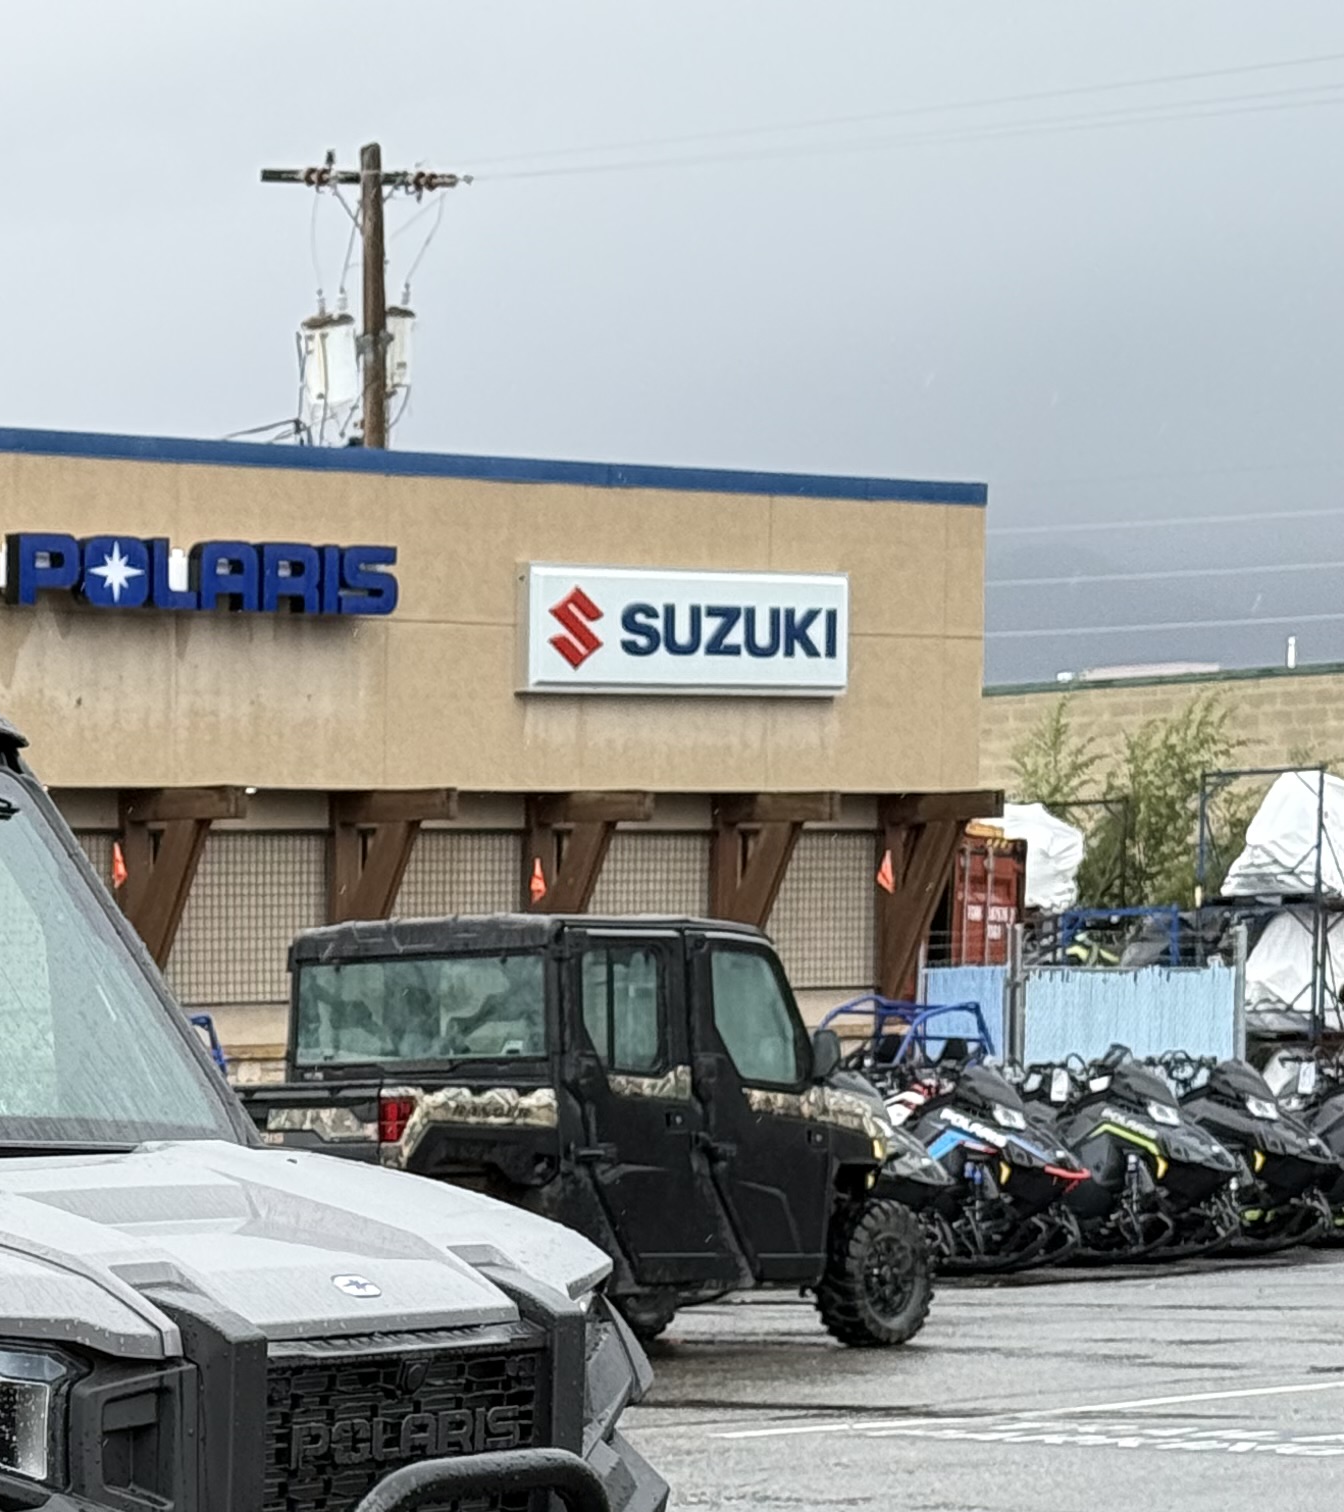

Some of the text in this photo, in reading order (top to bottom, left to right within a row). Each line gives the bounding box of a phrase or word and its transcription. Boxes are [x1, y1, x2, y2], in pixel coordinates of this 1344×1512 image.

[5, 534, 398, 614] POLARIS
[620, 603, 838, 659] SUZUKI
[290, 1404, 521, 1470] POLARIS
